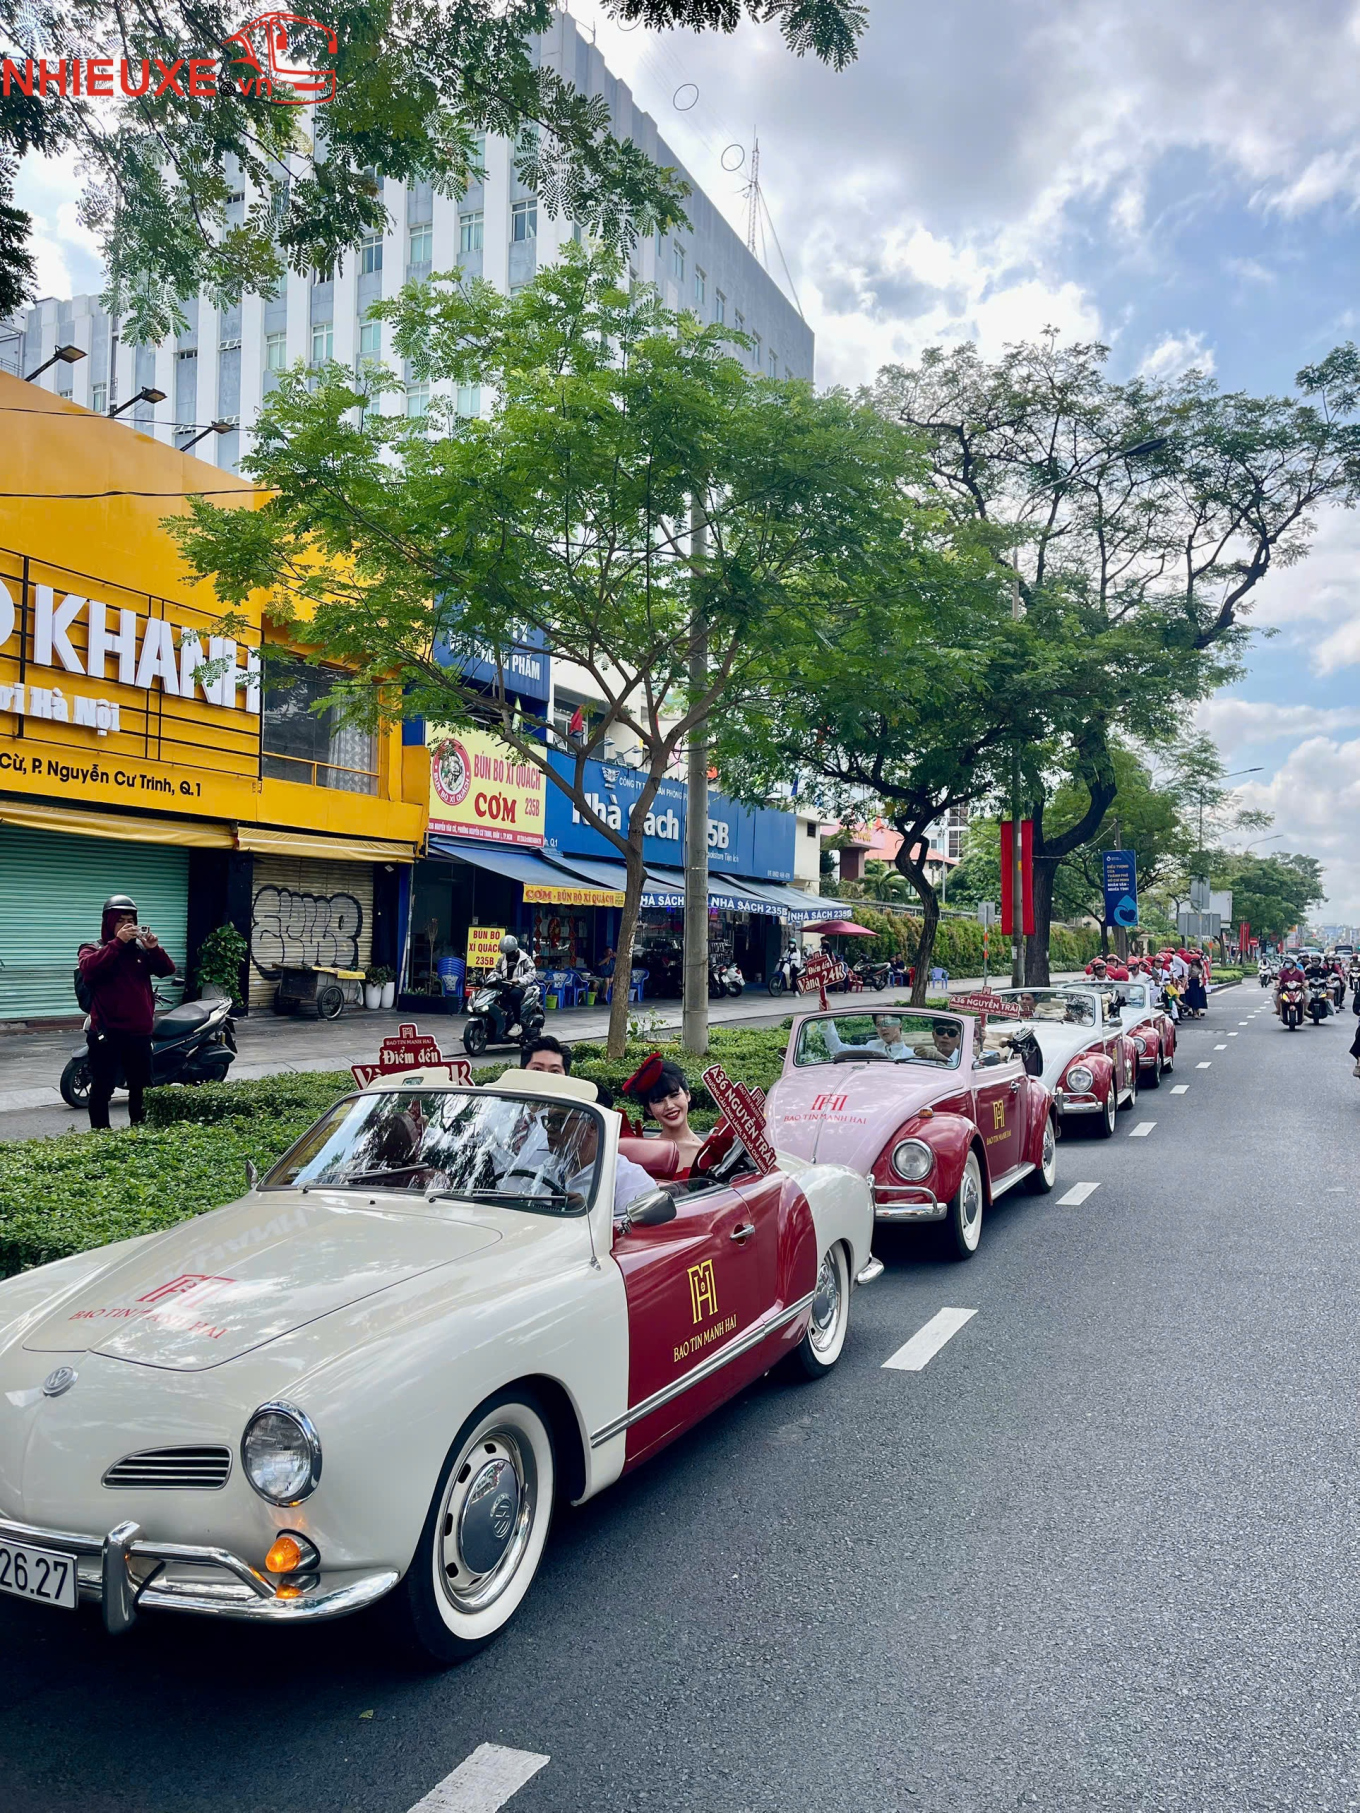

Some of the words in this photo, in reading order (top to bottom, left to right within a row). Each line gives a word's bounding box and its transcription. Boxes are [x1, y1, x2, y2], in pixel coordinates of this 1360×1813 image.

[29, 686, 69, 723] Hà
[73, 694, 121, 736] Nội
[47, 763, 110, 784] Nguyễn
[114, 769, 137, 788] Cư
[139, 774, 176, 796] Trinh,
[474, 791, 518, 824] CƠM
[524, 797, 541, 818] 235B
[657, 893, 685, 906] SÁCH
[710, 896, 735, 909] NHÀ
[737, 899, 764, 913] SÁCH
[790, 910, 811, 922] NHÀ
[811, 909, 834, 920] SÁCH
[473, 928, 489, 940] BÚN
[490, 928, 501, 940] BÒ
[475, 956, 495, 966] 235B
[382, 1046, 415, 1065] Điểm
[418, 1046, 439, 1063] đến
[710, 1066, 729, 1090] A36
[725, 1090, 759, 1140] NGUYỄN
[849, 1116, 867, 1125] HAI
[68, 1308, 107, 1321] BAO
[103, 1308, 138, 1319] TIN
[187, 1320, 229, 1341] HAI
[673, 1340, 690, 1363] BAO
[689, 1333, 703, 1353] TIN
[703, 1321, 725, 1346] MANH
[724, 1313, 737, 1333] HAI
[0, 1548, 69, 1600] 26.27
